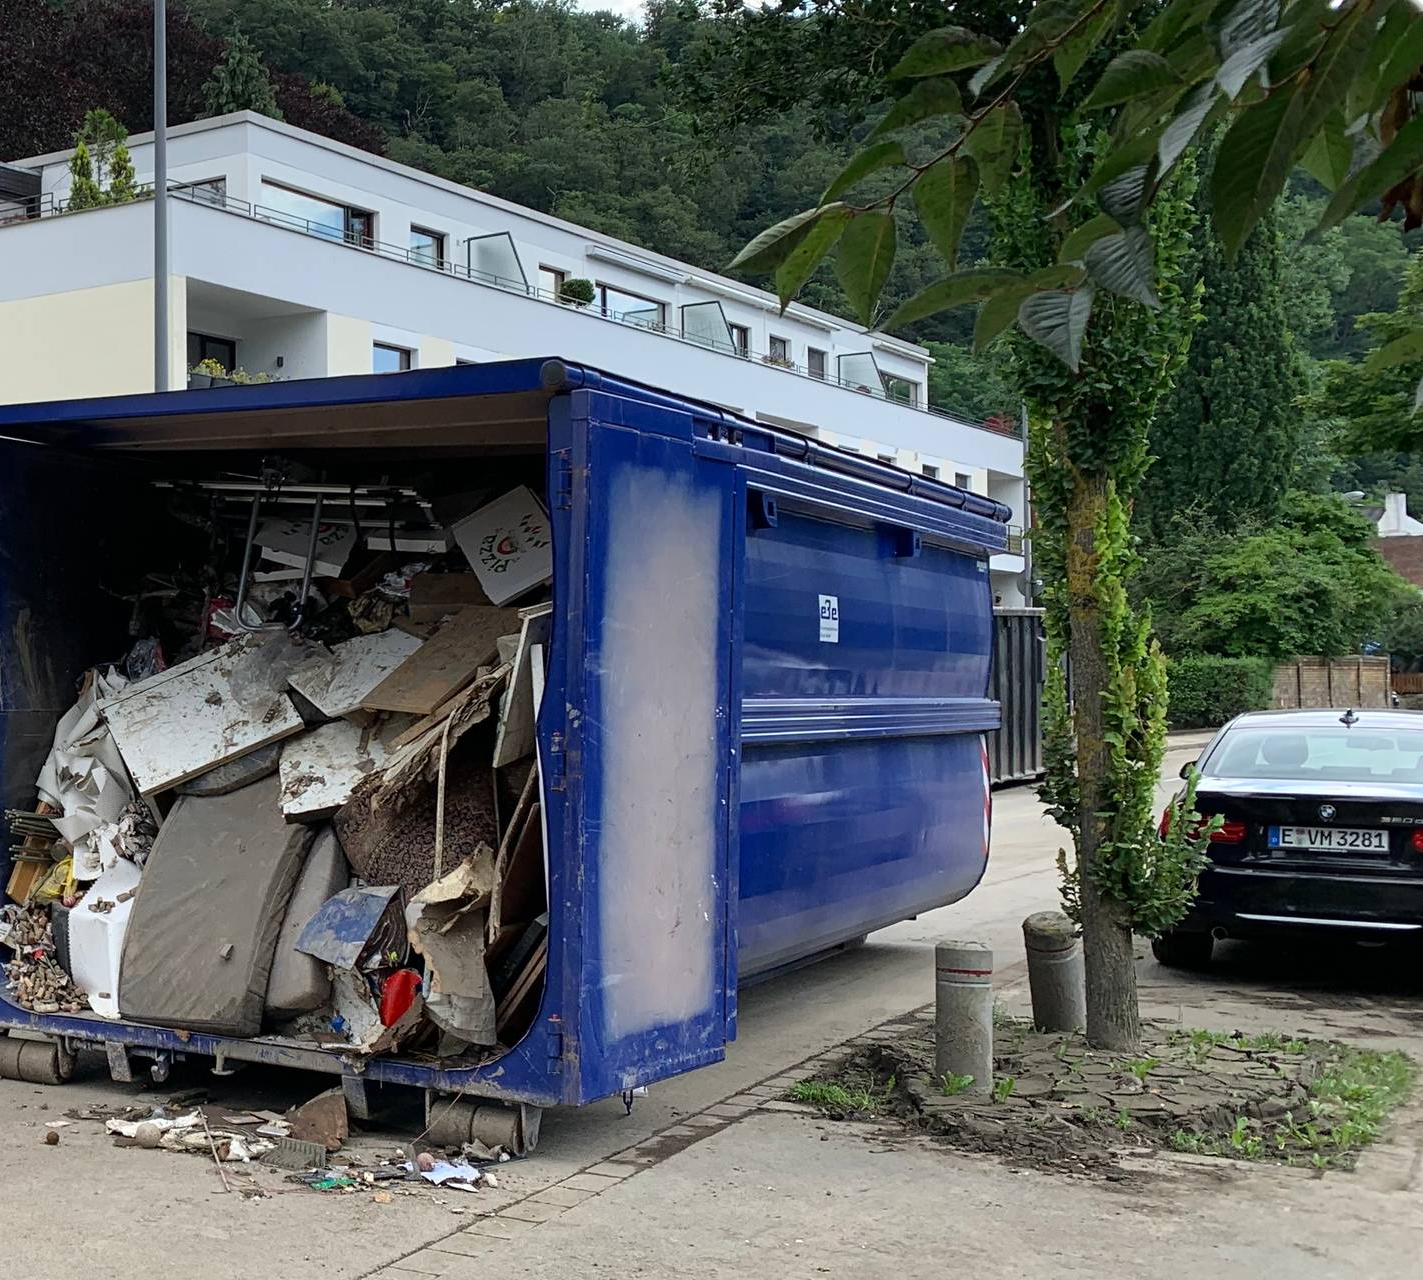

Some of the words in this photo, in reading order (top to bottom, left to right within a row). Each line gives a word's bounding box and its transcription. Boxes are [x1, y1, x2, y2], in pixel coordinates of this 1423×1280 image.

[1282, 828, 1293, 844] E
[1308, 830, 1332, 846] VM
[1337, 831, 1385, 848] 3281
